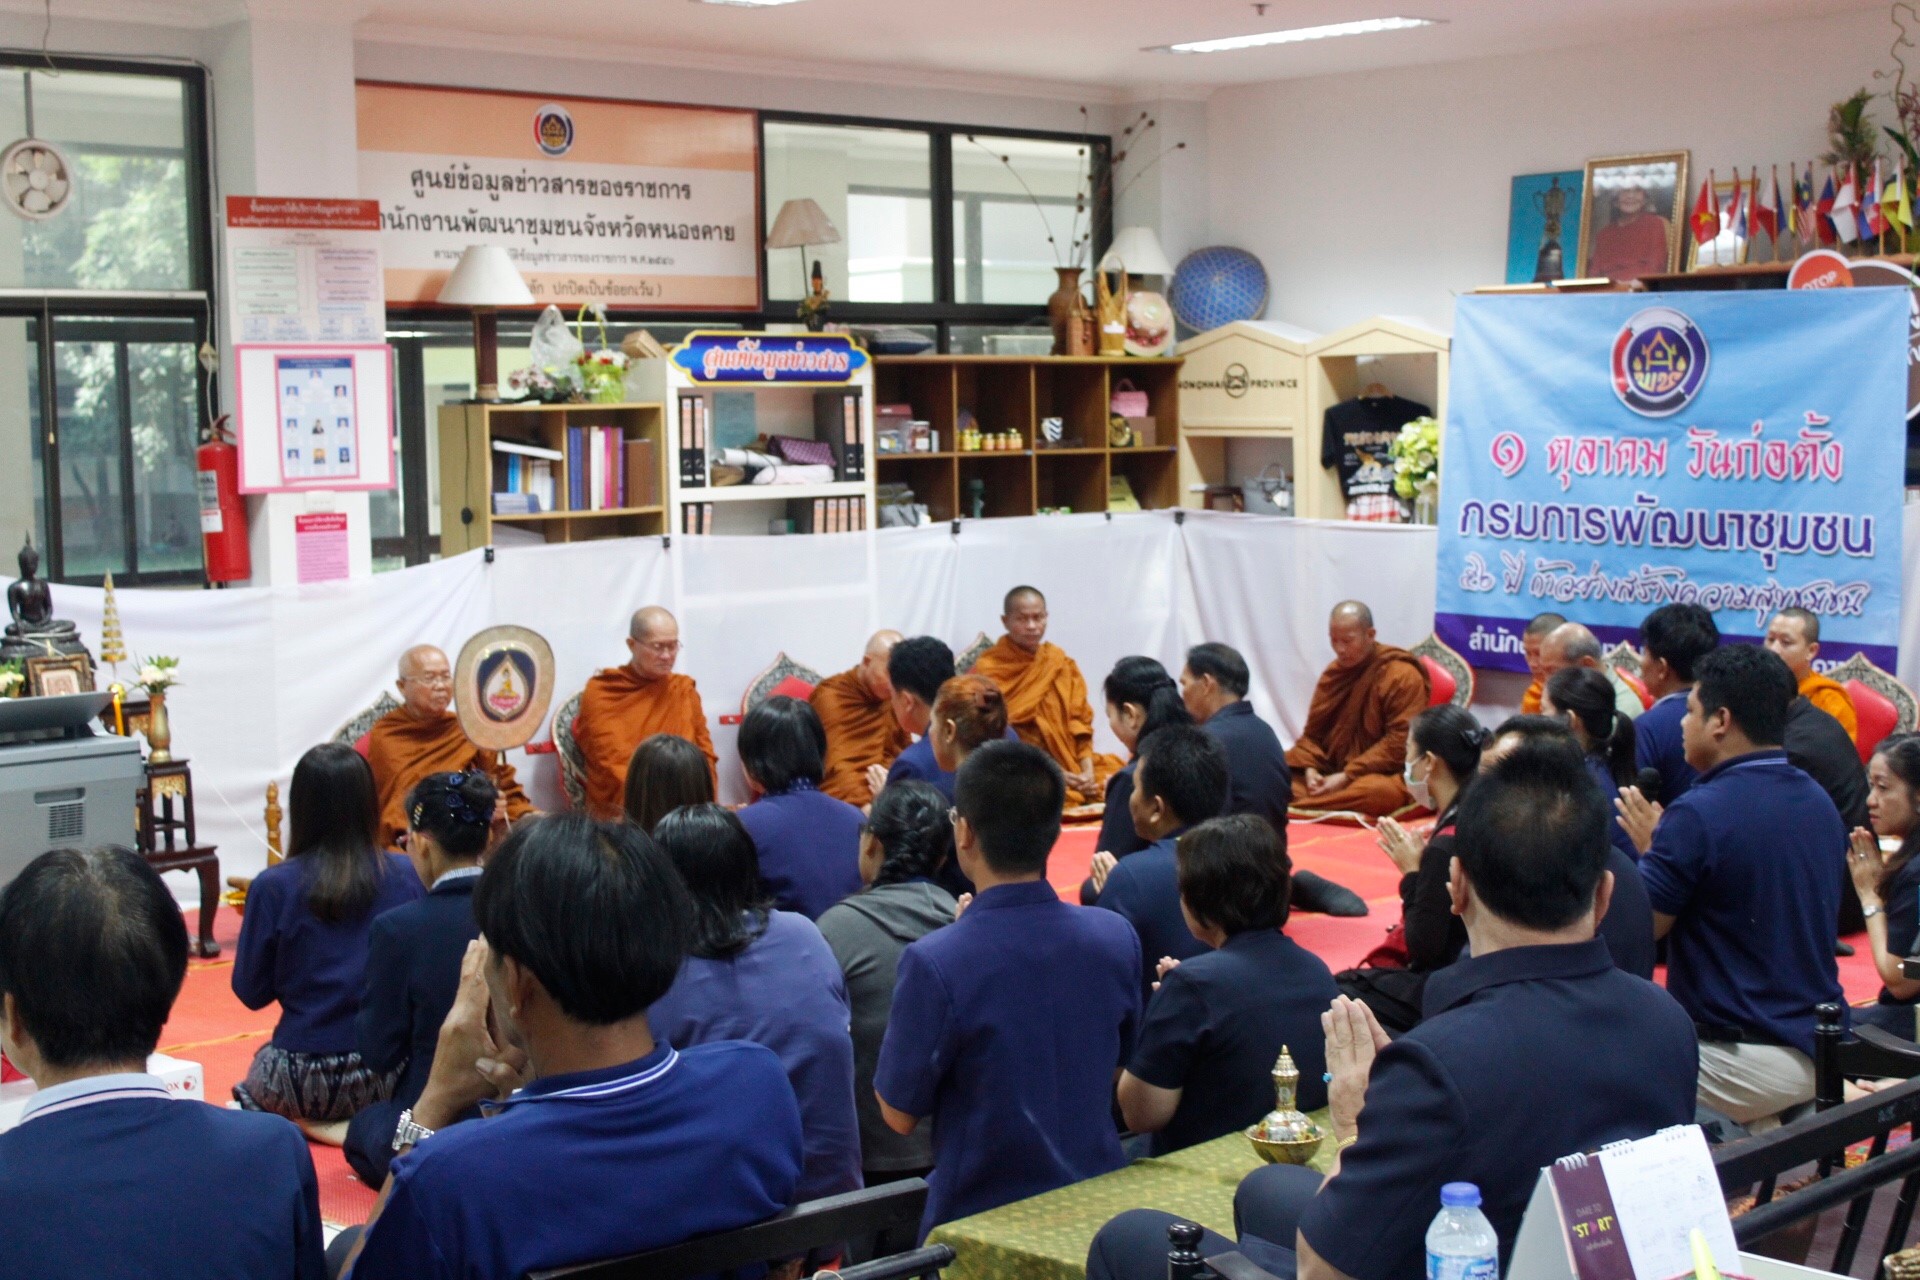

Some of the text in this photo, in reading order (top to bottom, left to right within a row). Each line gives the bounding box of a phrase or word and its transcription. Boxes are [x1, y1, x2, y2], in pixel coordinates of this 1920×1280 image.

[410, 163, 691, 201] ศูนย์ข้อมูลข่าวสารของราชการ
[379, 205, 736, 244] ำนักงานพัฒนาชุมชนจังหวัดหนองคาย
[1250, 378, 1298, 388] PROVINCE
[1490, 411, 1844, 491] ๑ ตุลาคม วันก่อตั้ง
[1458, 493, 1876, 571] กรมการพัฒนาชุมชน
[1503, 549, 1527, 594] ปี
